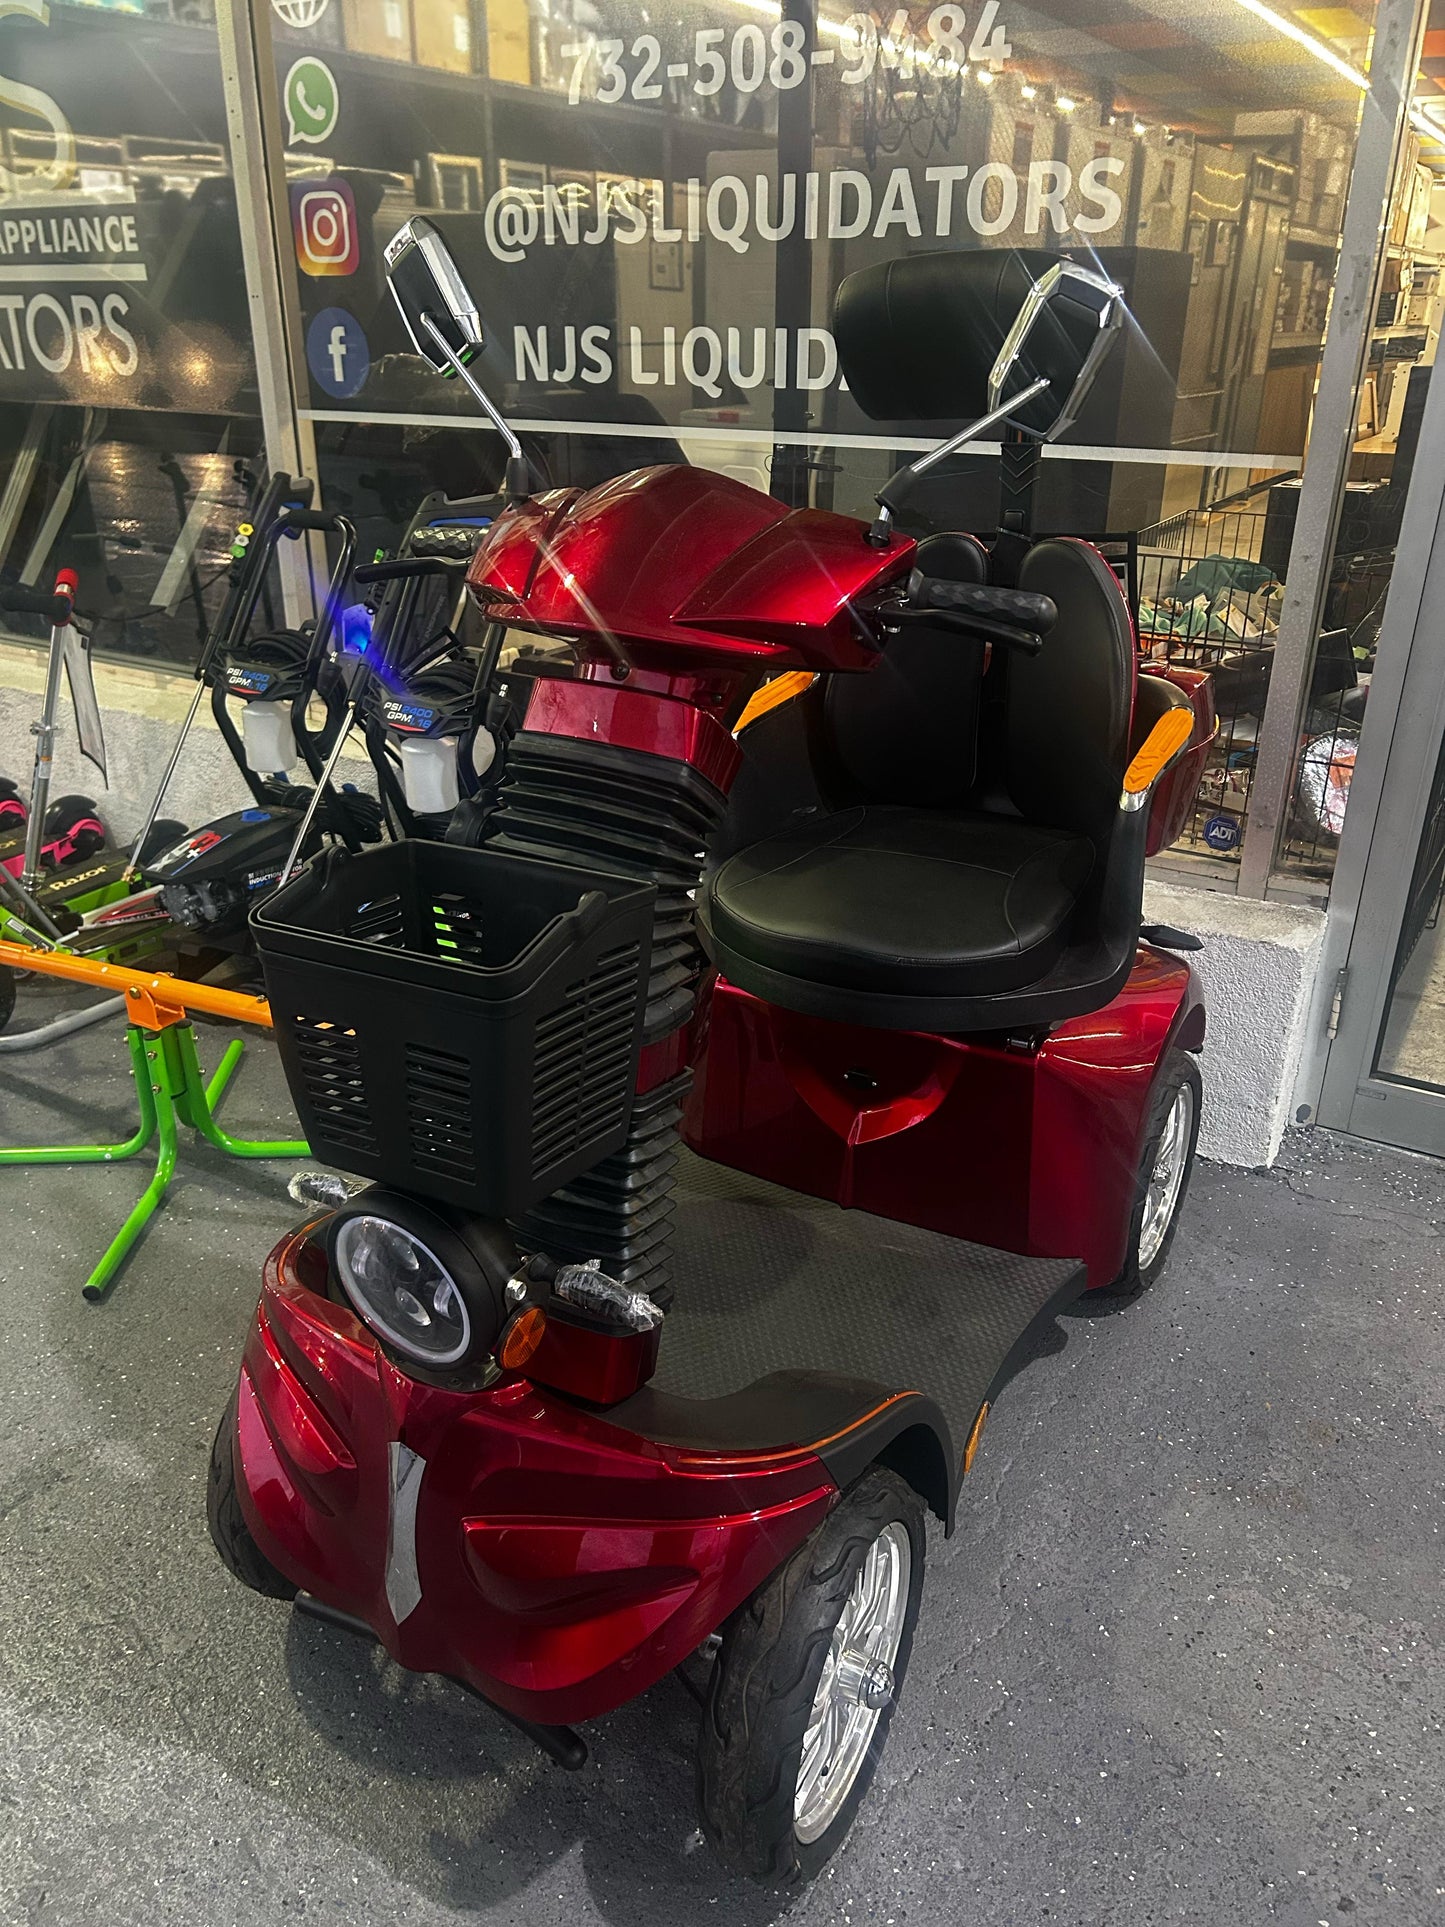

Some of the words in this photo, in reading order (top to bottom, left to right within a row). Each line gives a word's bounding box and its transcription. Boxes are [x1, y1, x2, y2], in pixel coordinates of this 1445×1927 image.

[561, 0, 1012, 105] 732-508-9484
[484, 156, 1125, 263] @NJSLIQUIDATORS
[513, 325, 612, 384] NJS
[630, 326, 850, 398] LIQUID
[227, 668, 243, 676] PSI
[229, 676, 251, 687] GPM
[383, 701, 402, 711] PSI
[402, 705, 433, 718] 2400
[386, 711, 412, 723] GPM
[1209, 826, 1235, 840] ADT
[49, 864, 108, 891] Razor
